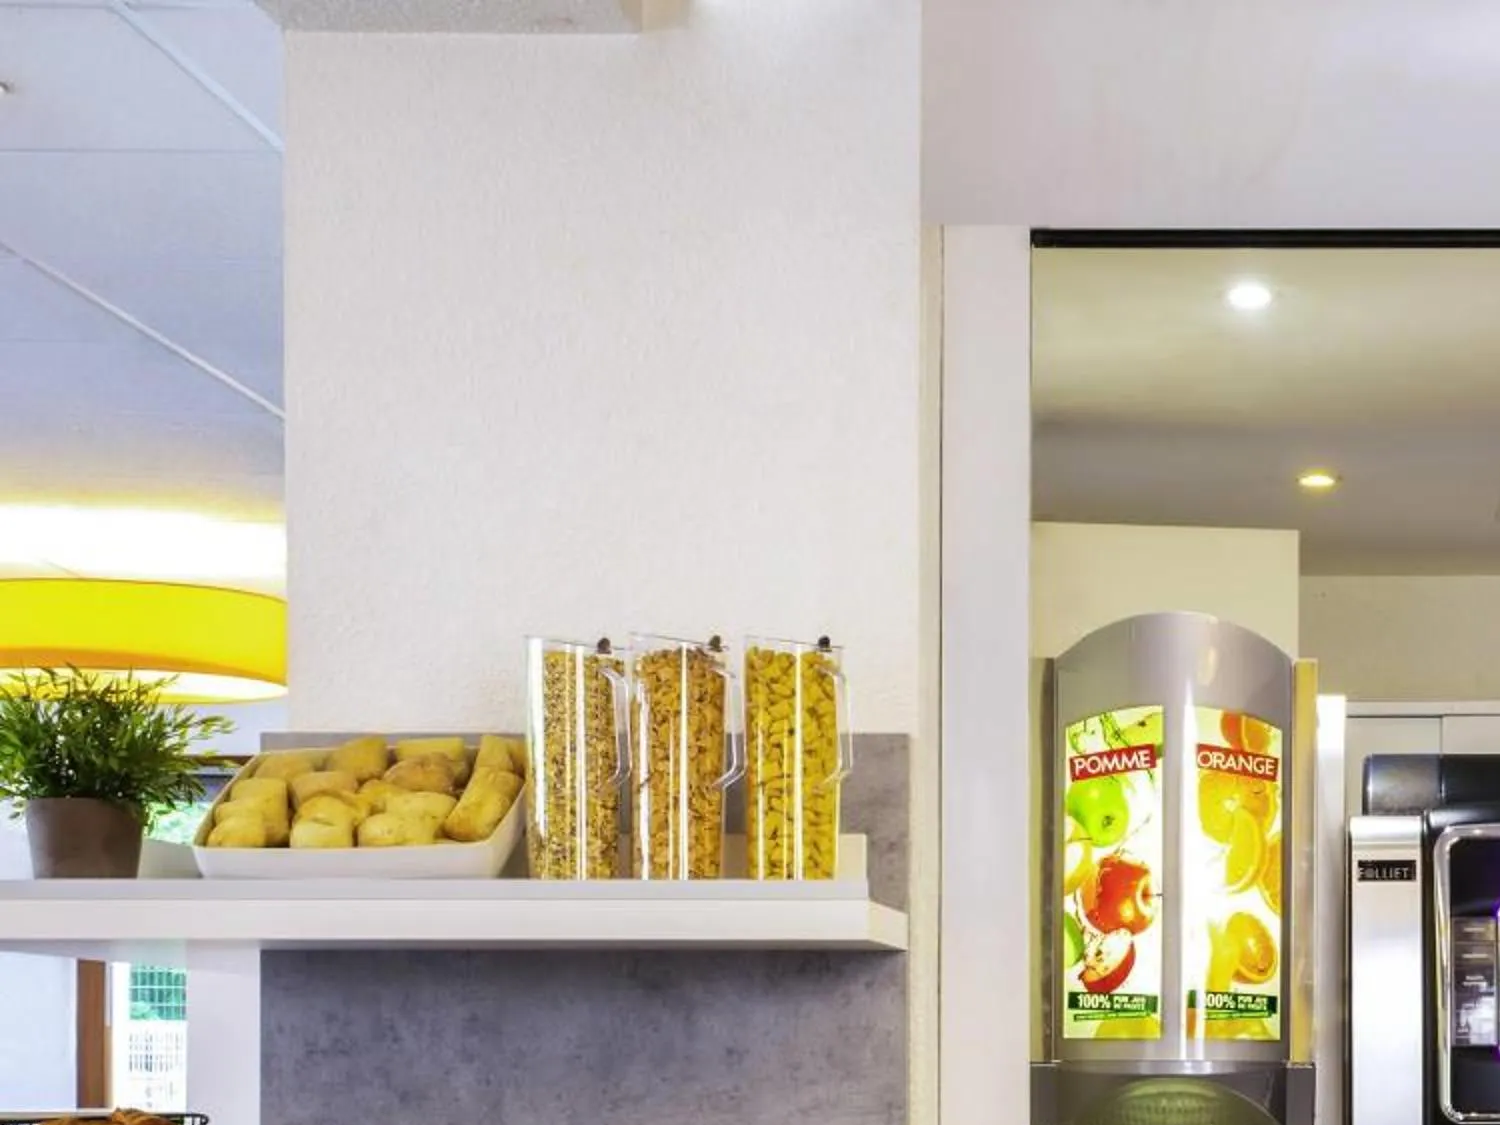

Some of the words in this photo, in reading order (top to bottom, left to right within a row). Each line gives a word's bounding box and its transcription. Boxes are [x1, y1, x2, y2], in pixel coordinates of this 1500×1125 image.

[1074, 750, 1151, 776] POMME
[1197, 751, 1275, 775] ORANGE
[1077, 993, 1111, 1009] 100%
[1206, 993, 1237, 1009] 00%
